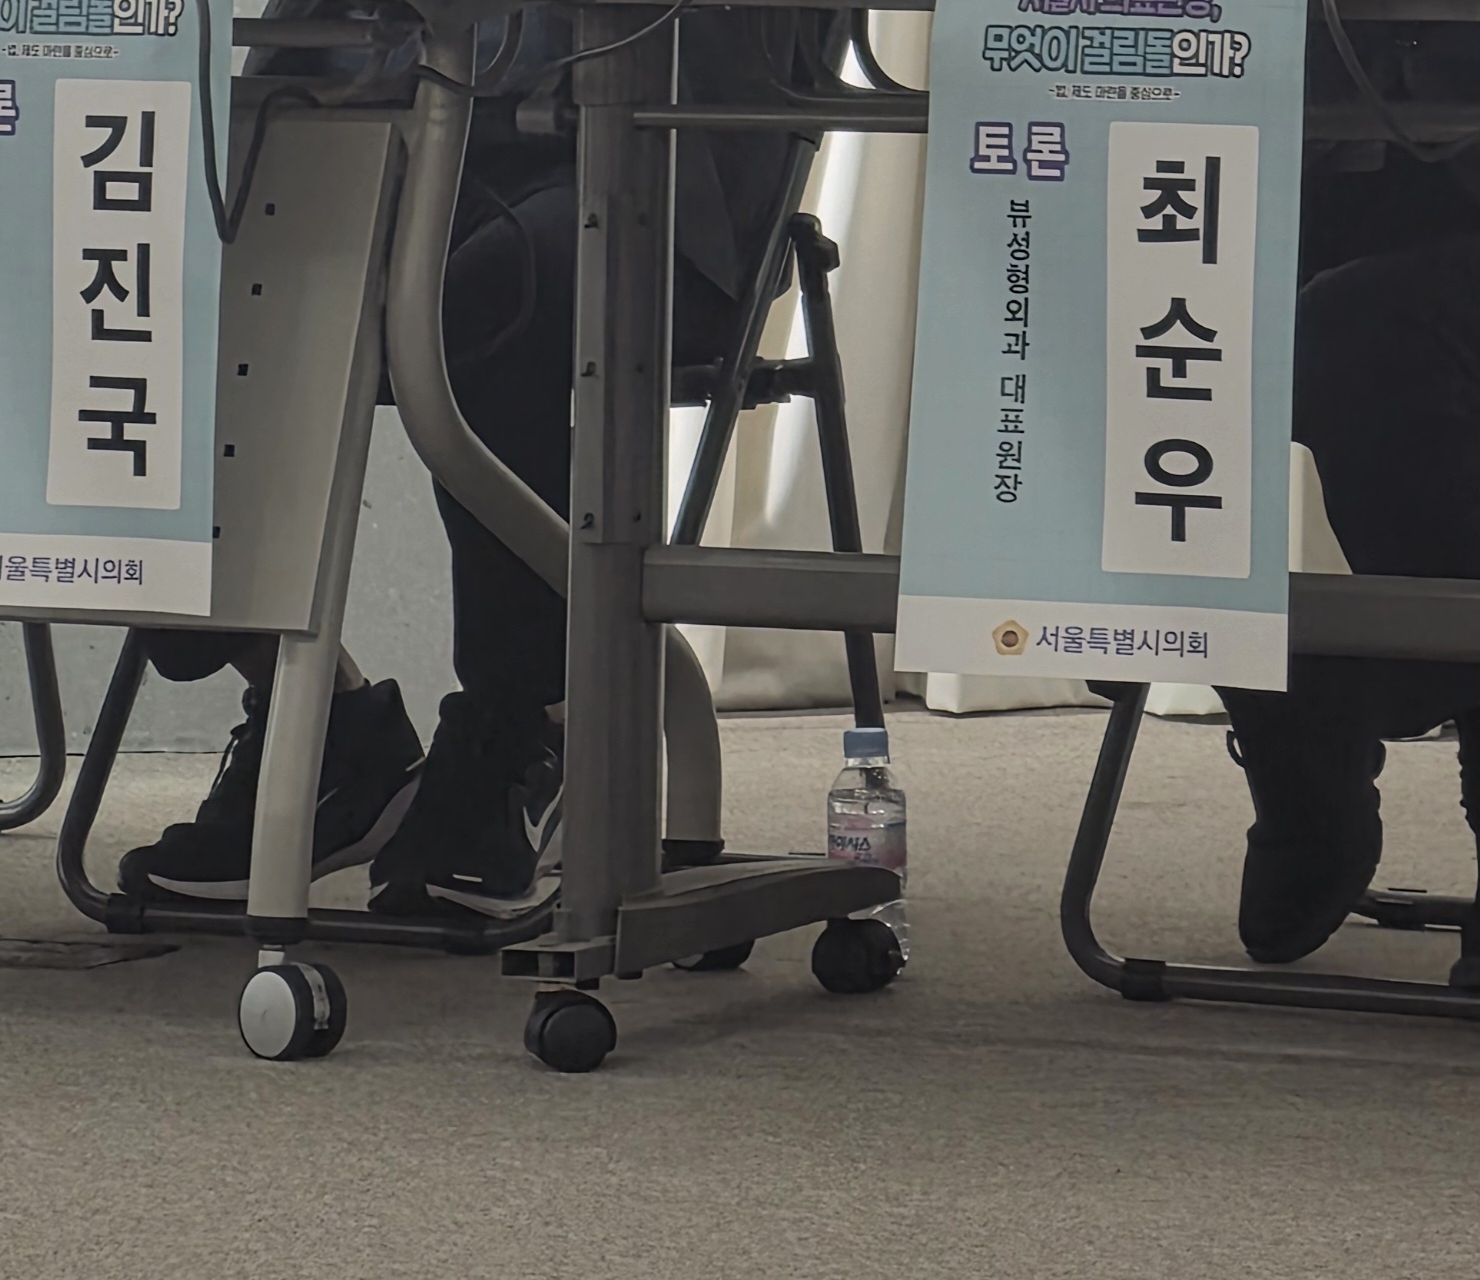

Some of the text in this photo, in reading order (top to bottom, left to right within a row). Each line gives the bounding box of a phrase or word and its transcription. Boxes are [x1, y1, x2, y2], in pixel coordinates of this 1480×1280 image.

[983, 25, 1252, 78] 무엇이 걸림돌인가?
[970, 121, 1070, 181] 토론
[78, 110, 158, 477] 김진국
[994, 199, 1032, 503] 뷰성형외과 대표원장
[1135, 155, 1223, 542] 최순우
[1035, 625, 1209, 659] 서울특별시의회
